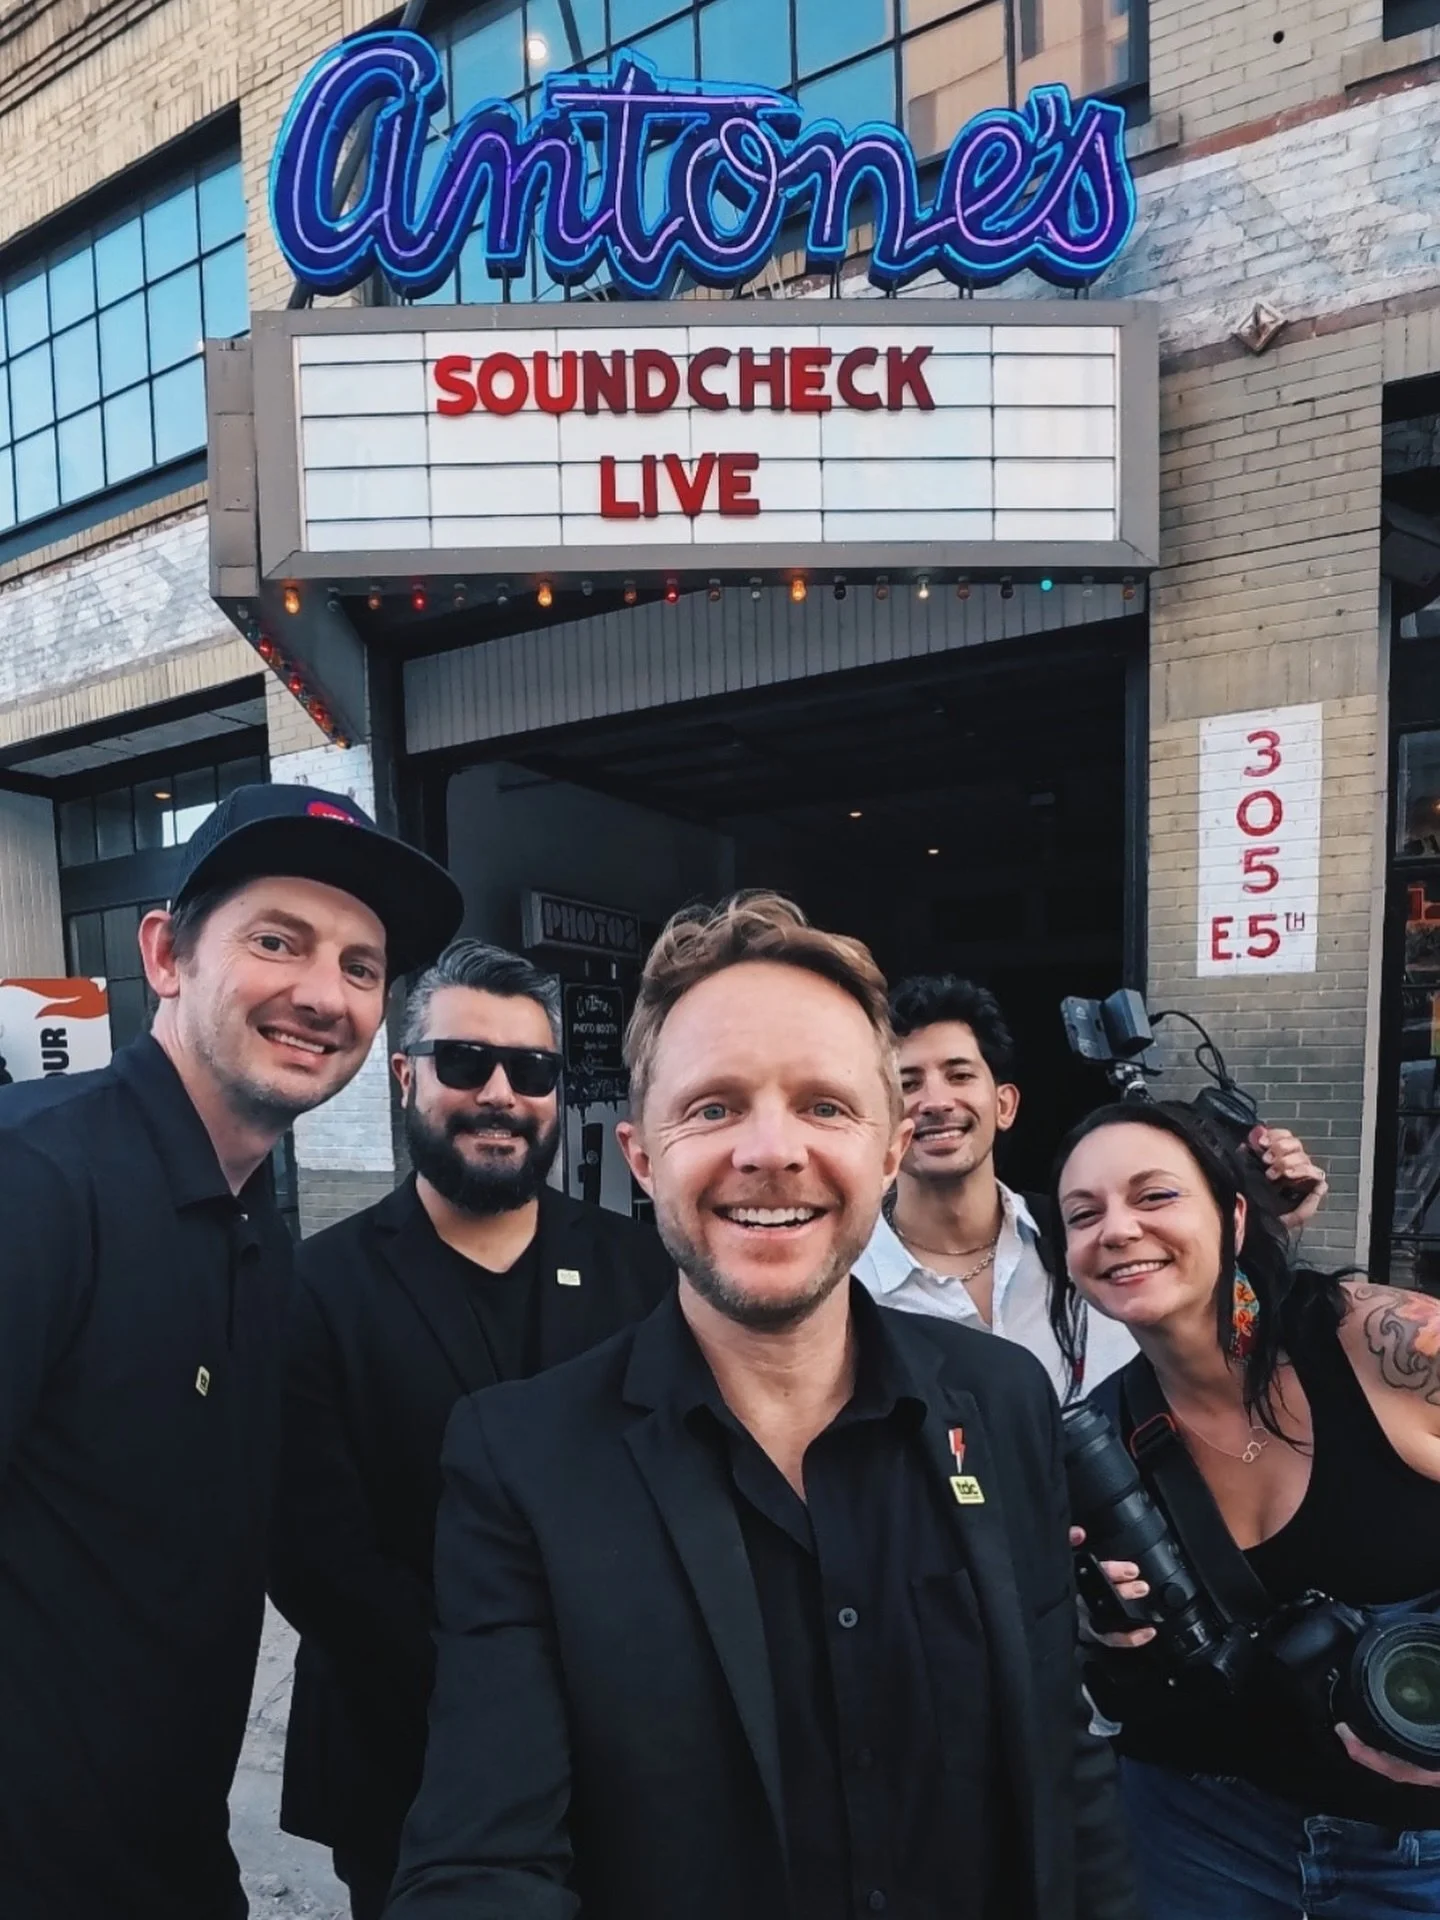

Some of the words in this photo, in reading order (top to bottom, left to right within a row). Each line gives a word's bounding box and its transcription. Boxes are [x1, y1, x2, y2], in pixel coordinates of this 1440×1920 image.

[433, 346, 937, 416] SOUNDCHECK
[599, 452, 761, 519] LIVE
[544, 901, 637, 949] PHOTOS
[41, 1028, 69, 1078] UR
